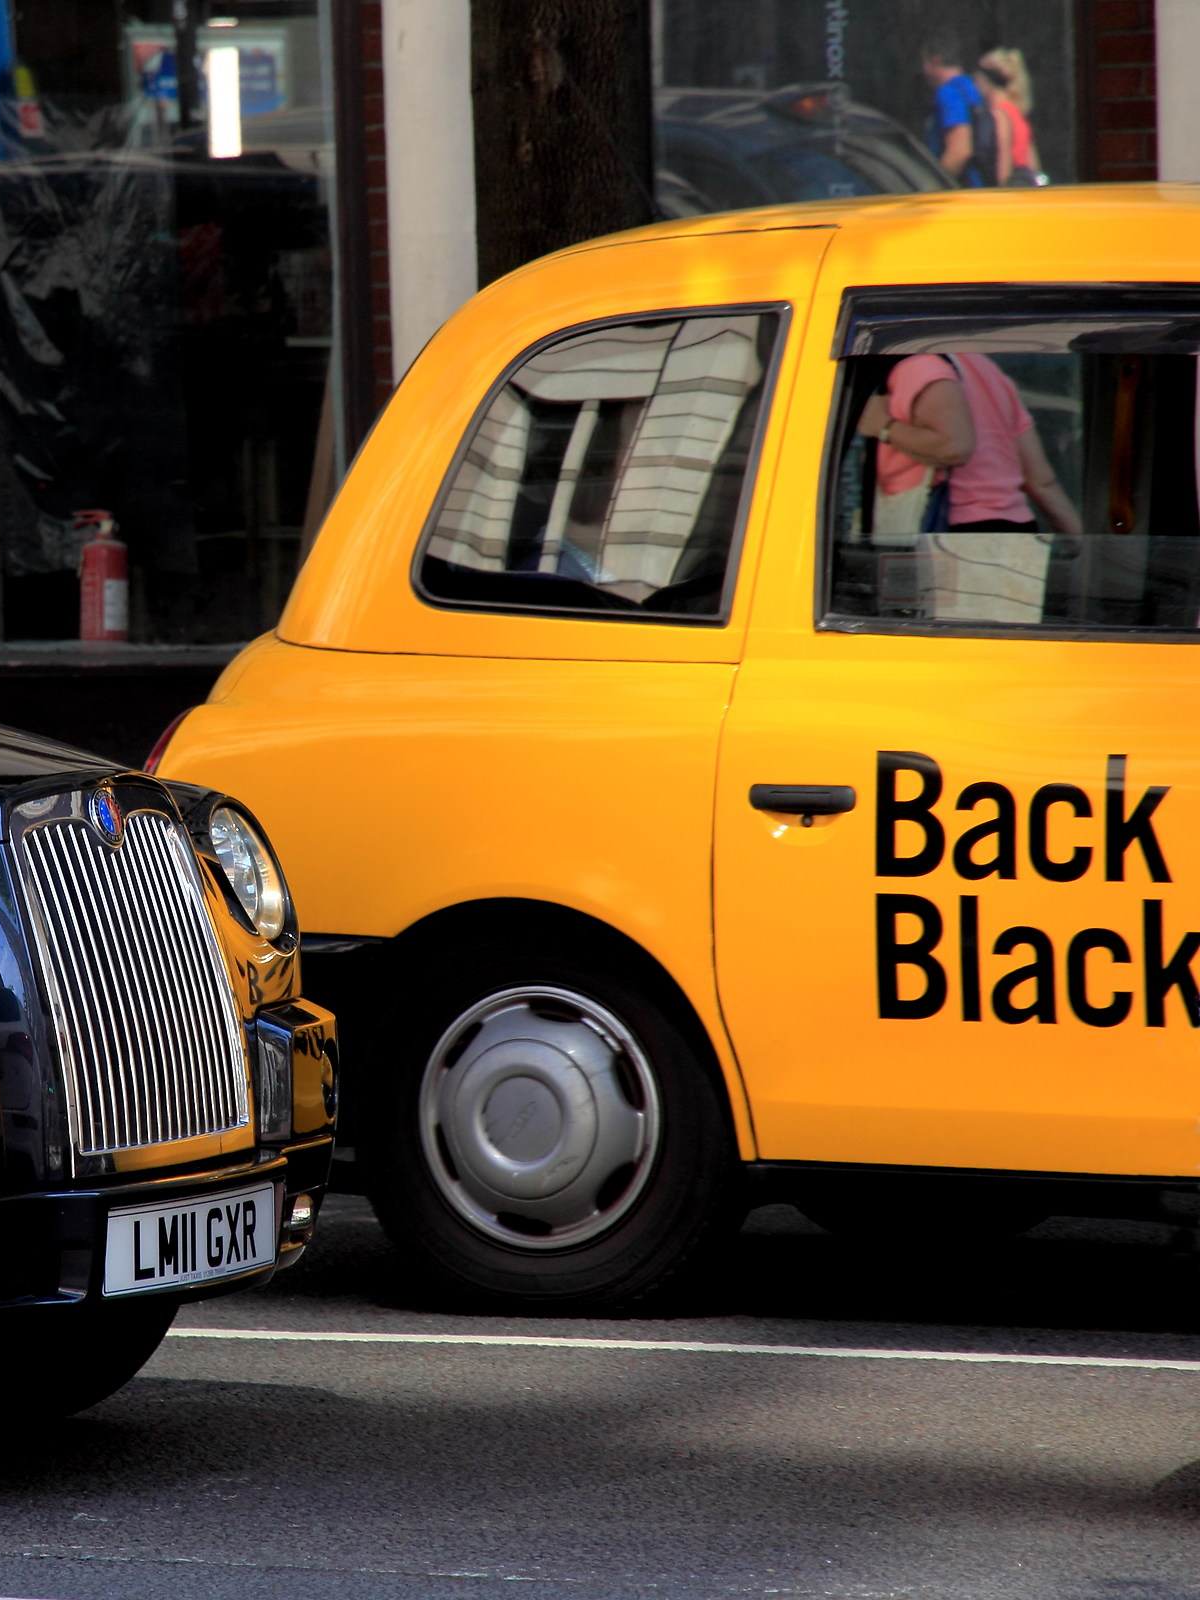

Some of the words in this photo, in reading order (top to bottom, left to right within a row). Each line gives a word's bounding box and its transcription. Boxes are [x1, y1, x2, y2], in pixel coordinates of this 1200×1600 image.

[875, 750, 1173, 883] Back
[875, 893, 1200, 1028] Black
[133, 1211, 196, 1281] LM11
[206, 1200, 257, 1268] GXR
